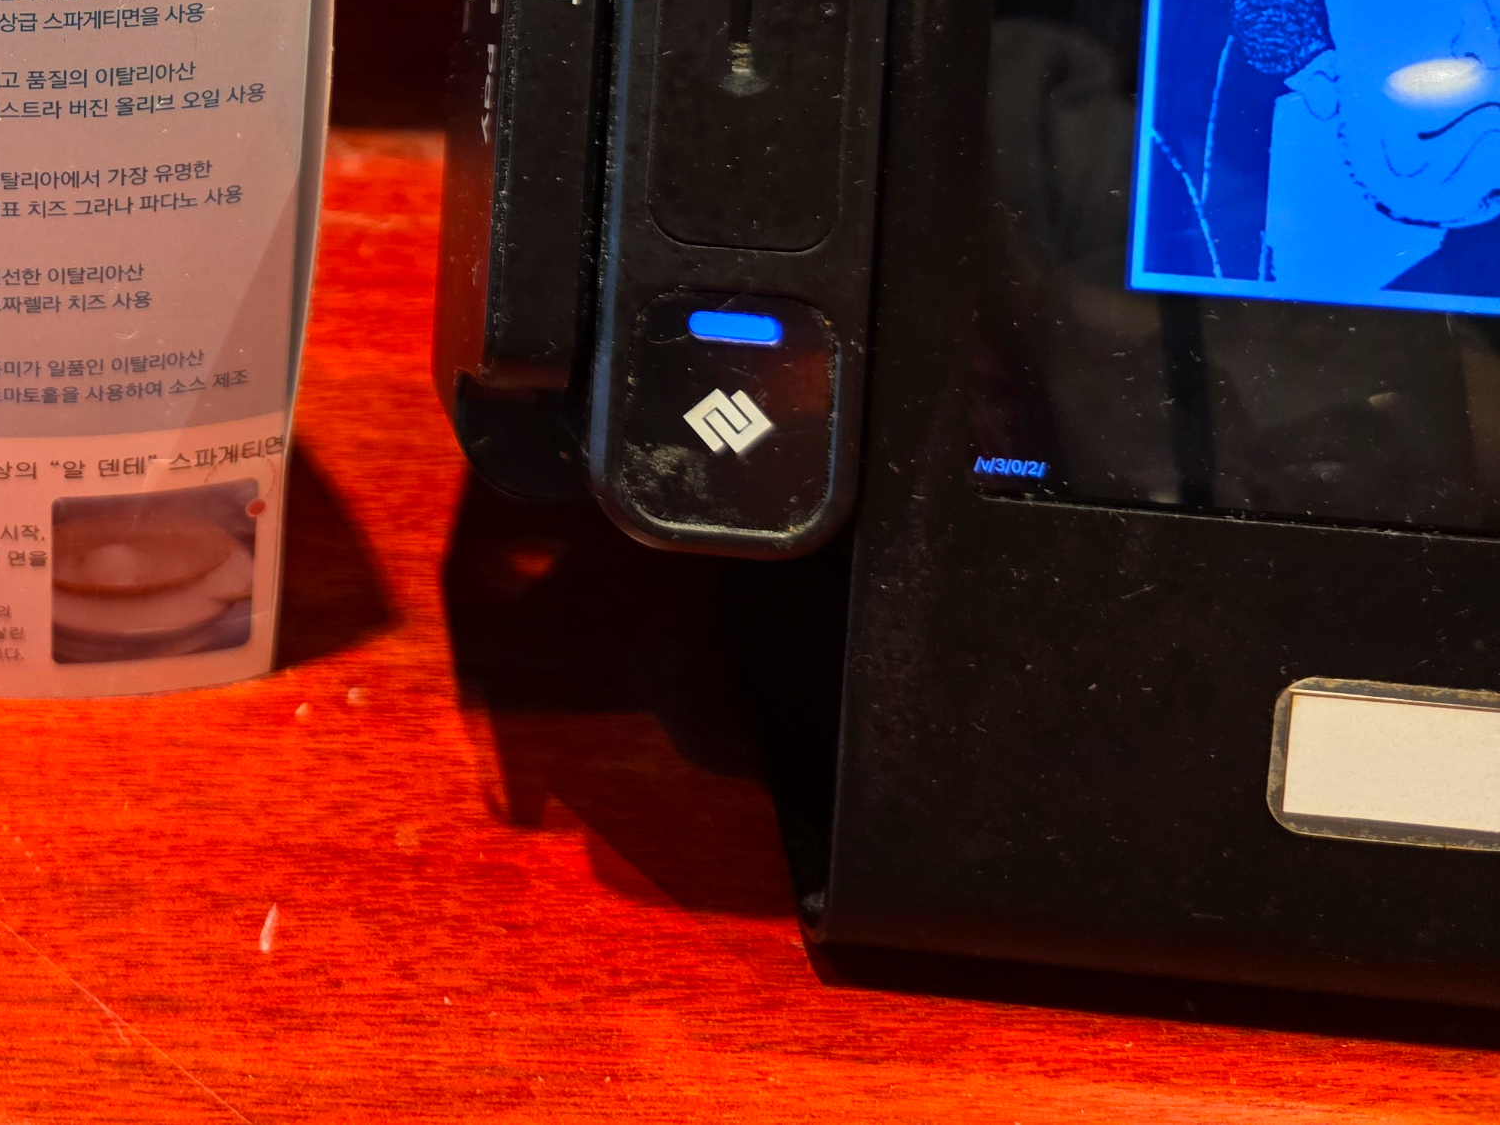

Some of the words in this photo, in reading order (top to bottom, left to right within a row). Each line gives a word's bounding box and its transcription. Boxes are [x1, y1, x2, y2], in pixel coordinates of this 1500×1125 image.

[43, 7, 160, 30] 스파게티면을
[165, 3, 205, 23] 사용
[26, 69, 87, 89] 품질의
[96, 61, 196, 87] 이탈리아산
[70, 98, 108, 118] 버진
[115, 94, 175, 116] 올리브
[181, 89, 219, 109] 오일
[226, 83, 266, 104] 사용
[108, 166, 148, 186] 가장
[154, 160, 212, 183] 유명한
[28, 201, 67, 218] 치즈
[73, 197, 134, 216] 그라나
[139, 193, 198, 212] 파다노
[204, 185, 243, 205] 사용
[48, 263, 144, 285] 이탈리아산
[68, 295, 106, 312] 치즈
[112, 291, 152, 310] 사용
[47, 359, 104, 377] 일품인
[111, 349, 205, 373] 이탈리아산
[85, 381, 162, 402] 사용하여
[168, 377, 206, 394] 소스
[212, 369, 248, 389] 제조
[169, 435, 283, 471] 스파게티면
[0, 525, 44, 541] 시작,
[8, 551, 45, 568] 면을
